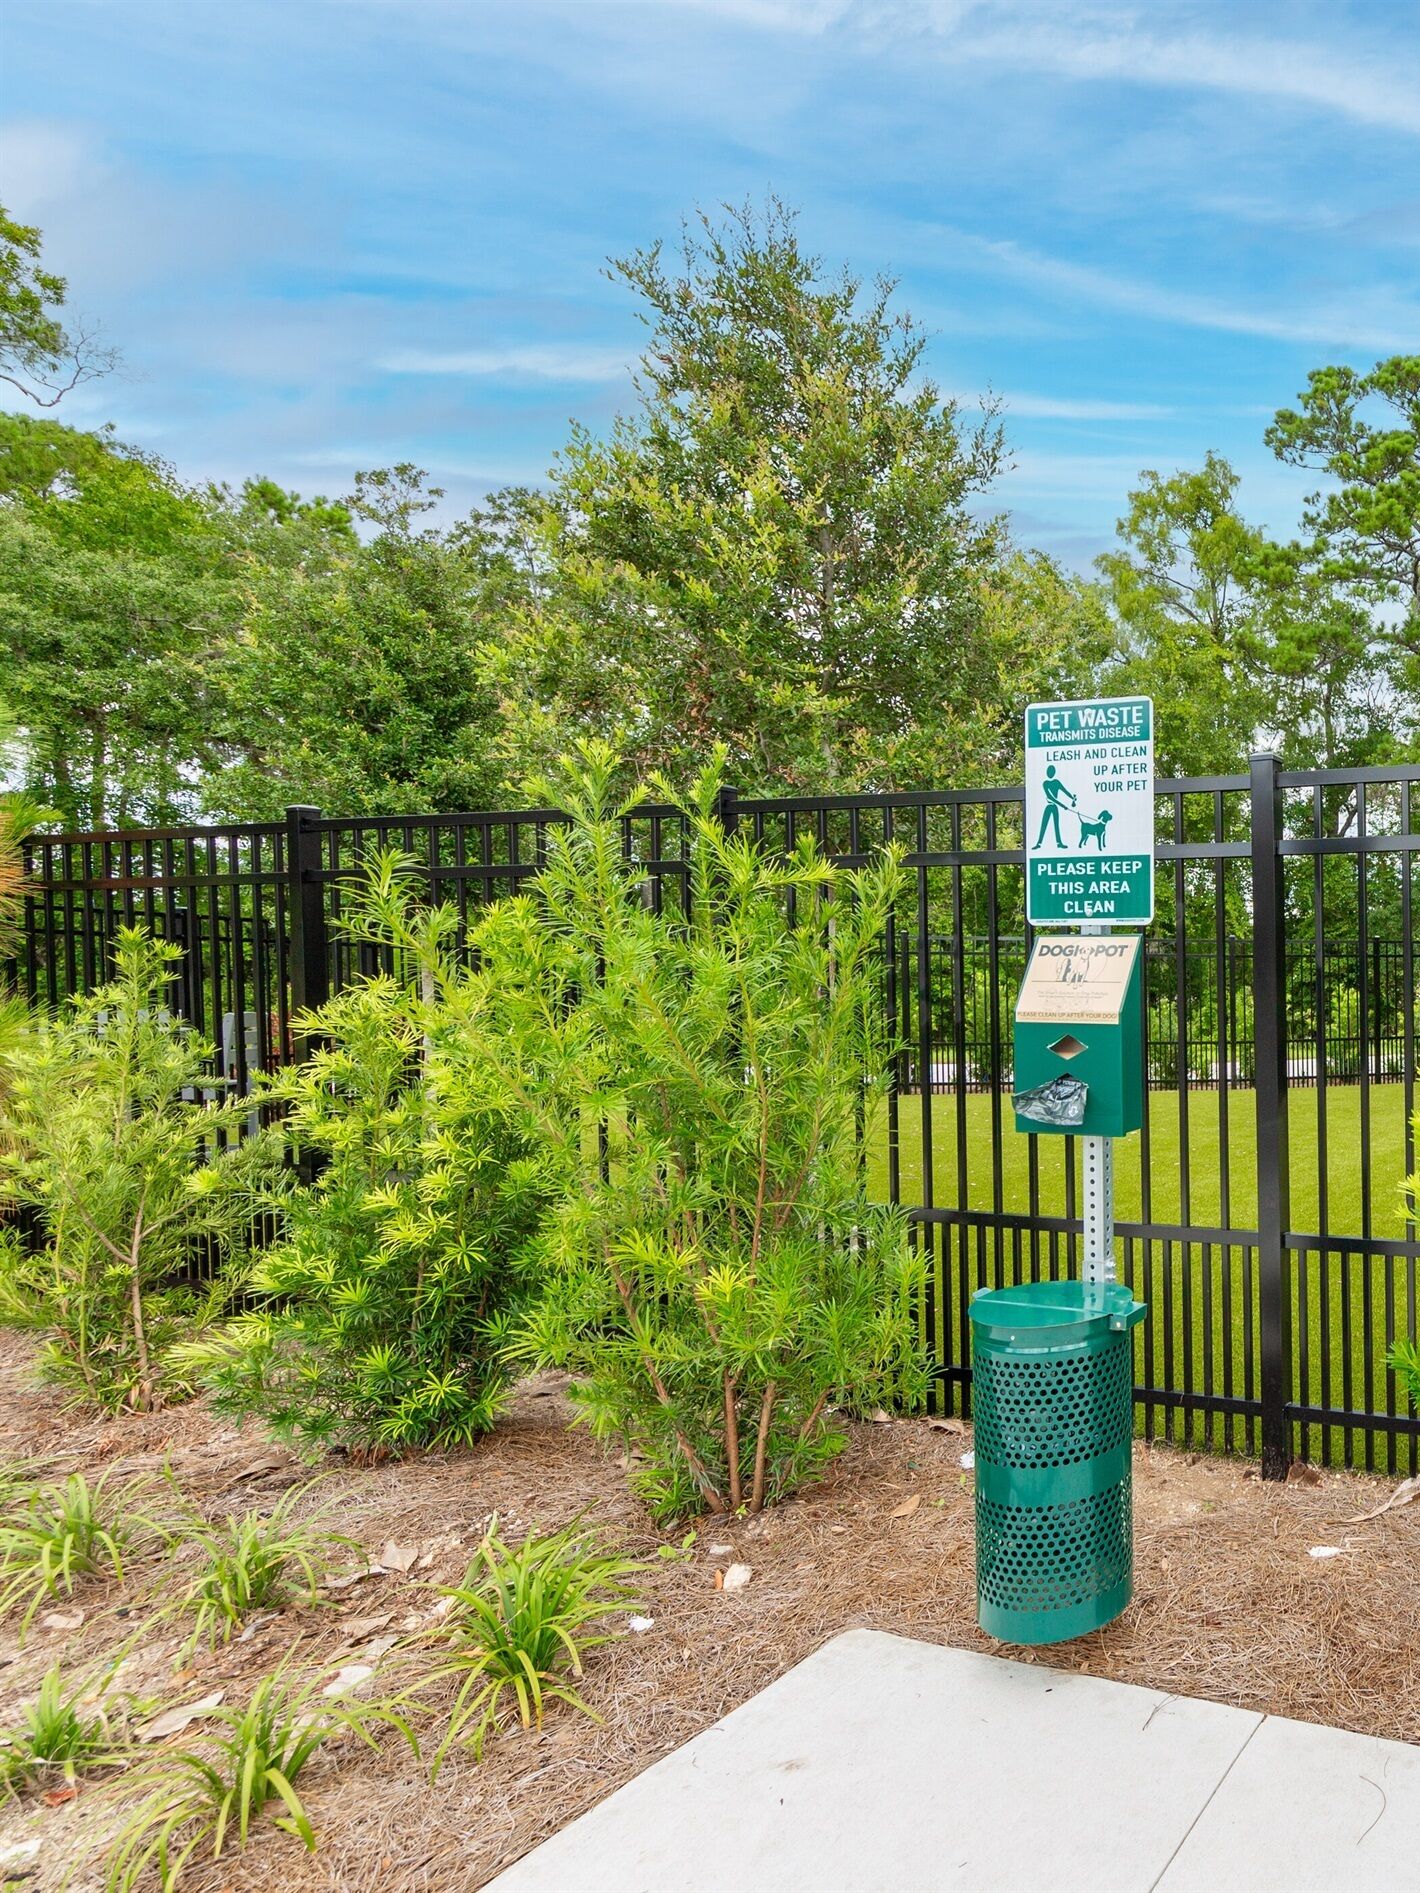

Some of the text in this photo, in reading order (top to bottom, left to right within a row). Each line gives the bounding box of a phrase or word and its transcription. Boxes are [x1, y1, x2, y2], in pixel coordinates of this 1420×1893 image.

[1036, 705, 1144, 731] PET WASTE
[1039, 726, 1141, 743] TRANSMITS DISEASE
[1046, 746, 1147, 762] LEASH AND CLEAN
[1094, 763, 1147, 776] UP AFTER
[1094, 779, 1147, 793] YOUR PET
[1037, 860, 1142, 876] PLEASE KEEP
[1048, 880, 1131, 895] THIS AREA
[1063, 900, 1115, 914] CLEAN
